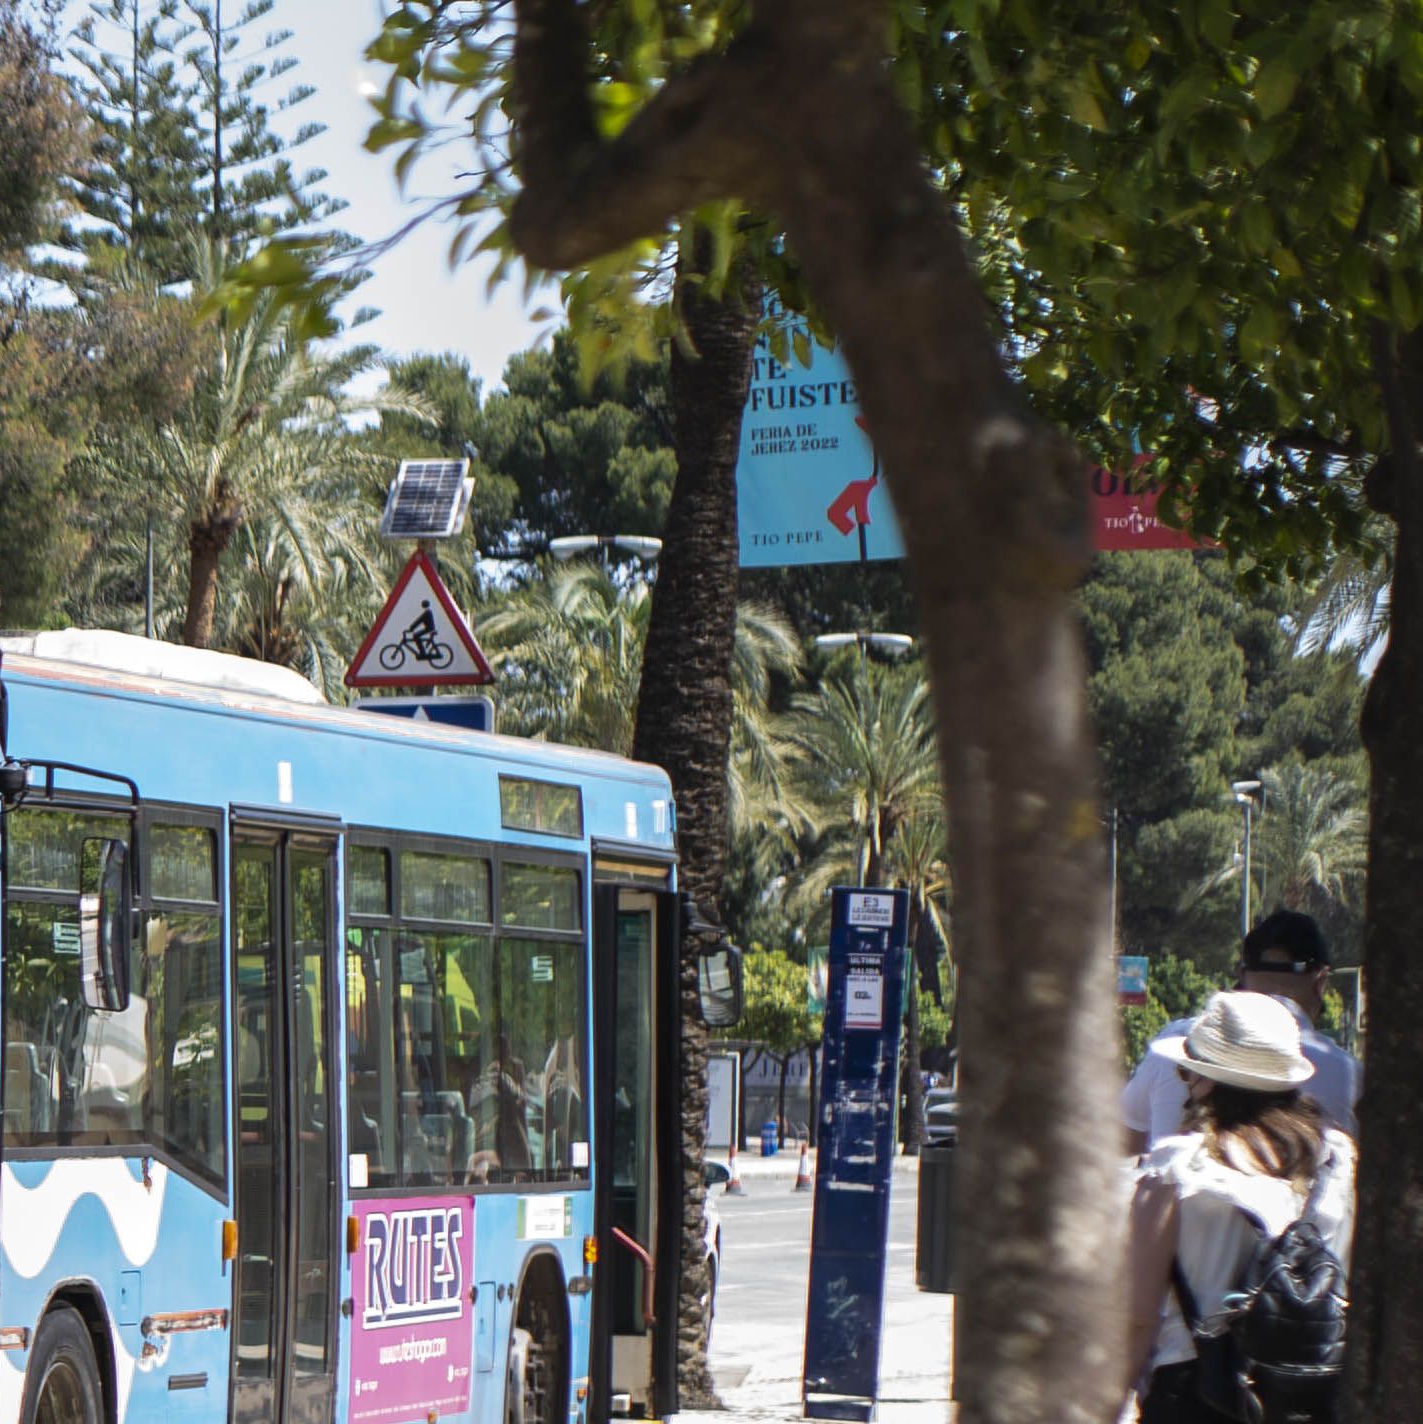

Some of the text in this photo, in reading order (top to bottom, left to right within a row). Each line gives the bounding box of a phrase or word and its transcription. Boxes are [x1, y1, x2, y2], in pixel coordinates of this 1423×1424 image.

[751, 381, 858, 412] FUISTE
[751, 423, 817, 441] FERIA DE
[751, 437, 840, 456] JEREZ 2022
[752, 530, 823, 547] TIO PEPE
[363, 1207, 464, 1318] RUTES
